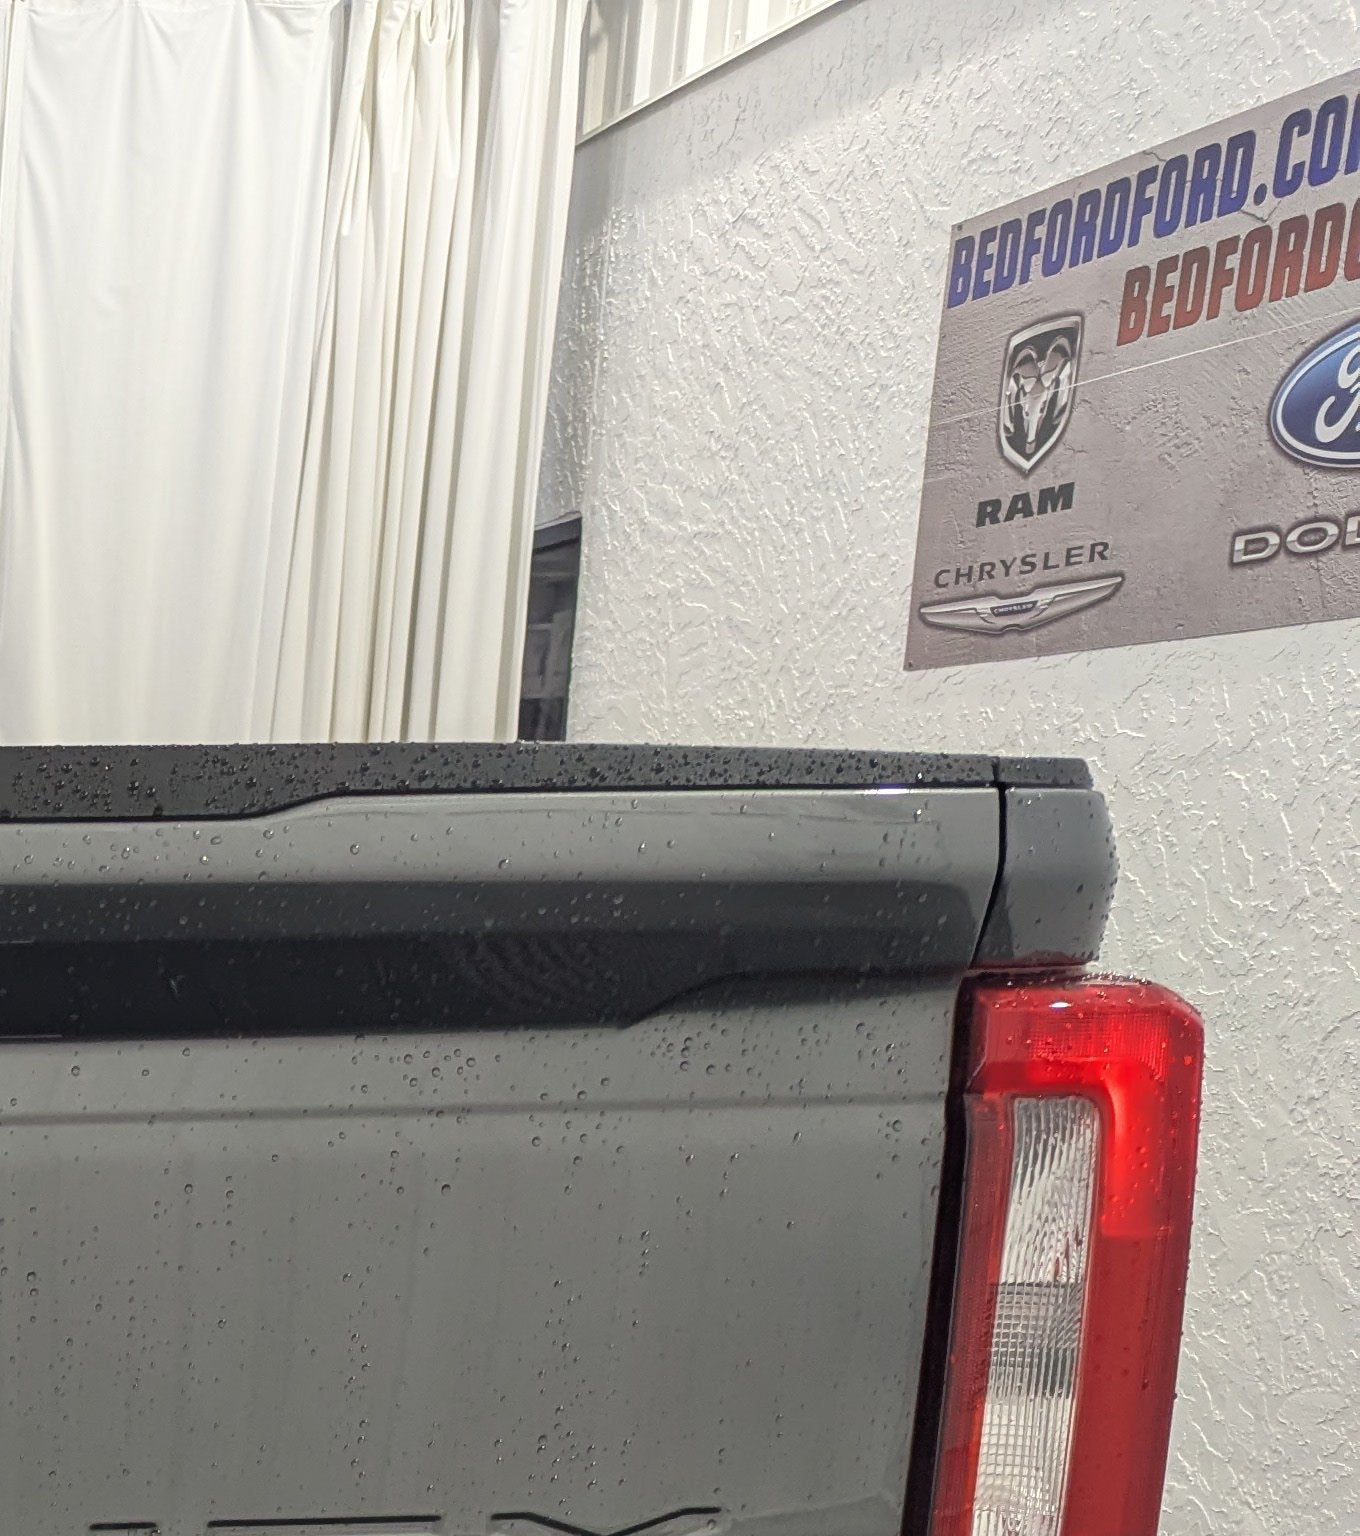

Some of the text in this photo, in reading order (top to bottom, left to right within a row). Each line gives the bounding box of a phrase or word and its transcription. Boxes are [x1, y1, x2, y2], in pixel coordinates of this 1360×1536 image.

[976, 481, 1076, 528] RAM
[1232, 515, 1360, 564] DO
[934, 540, 1111, 589] CHRYSLER
